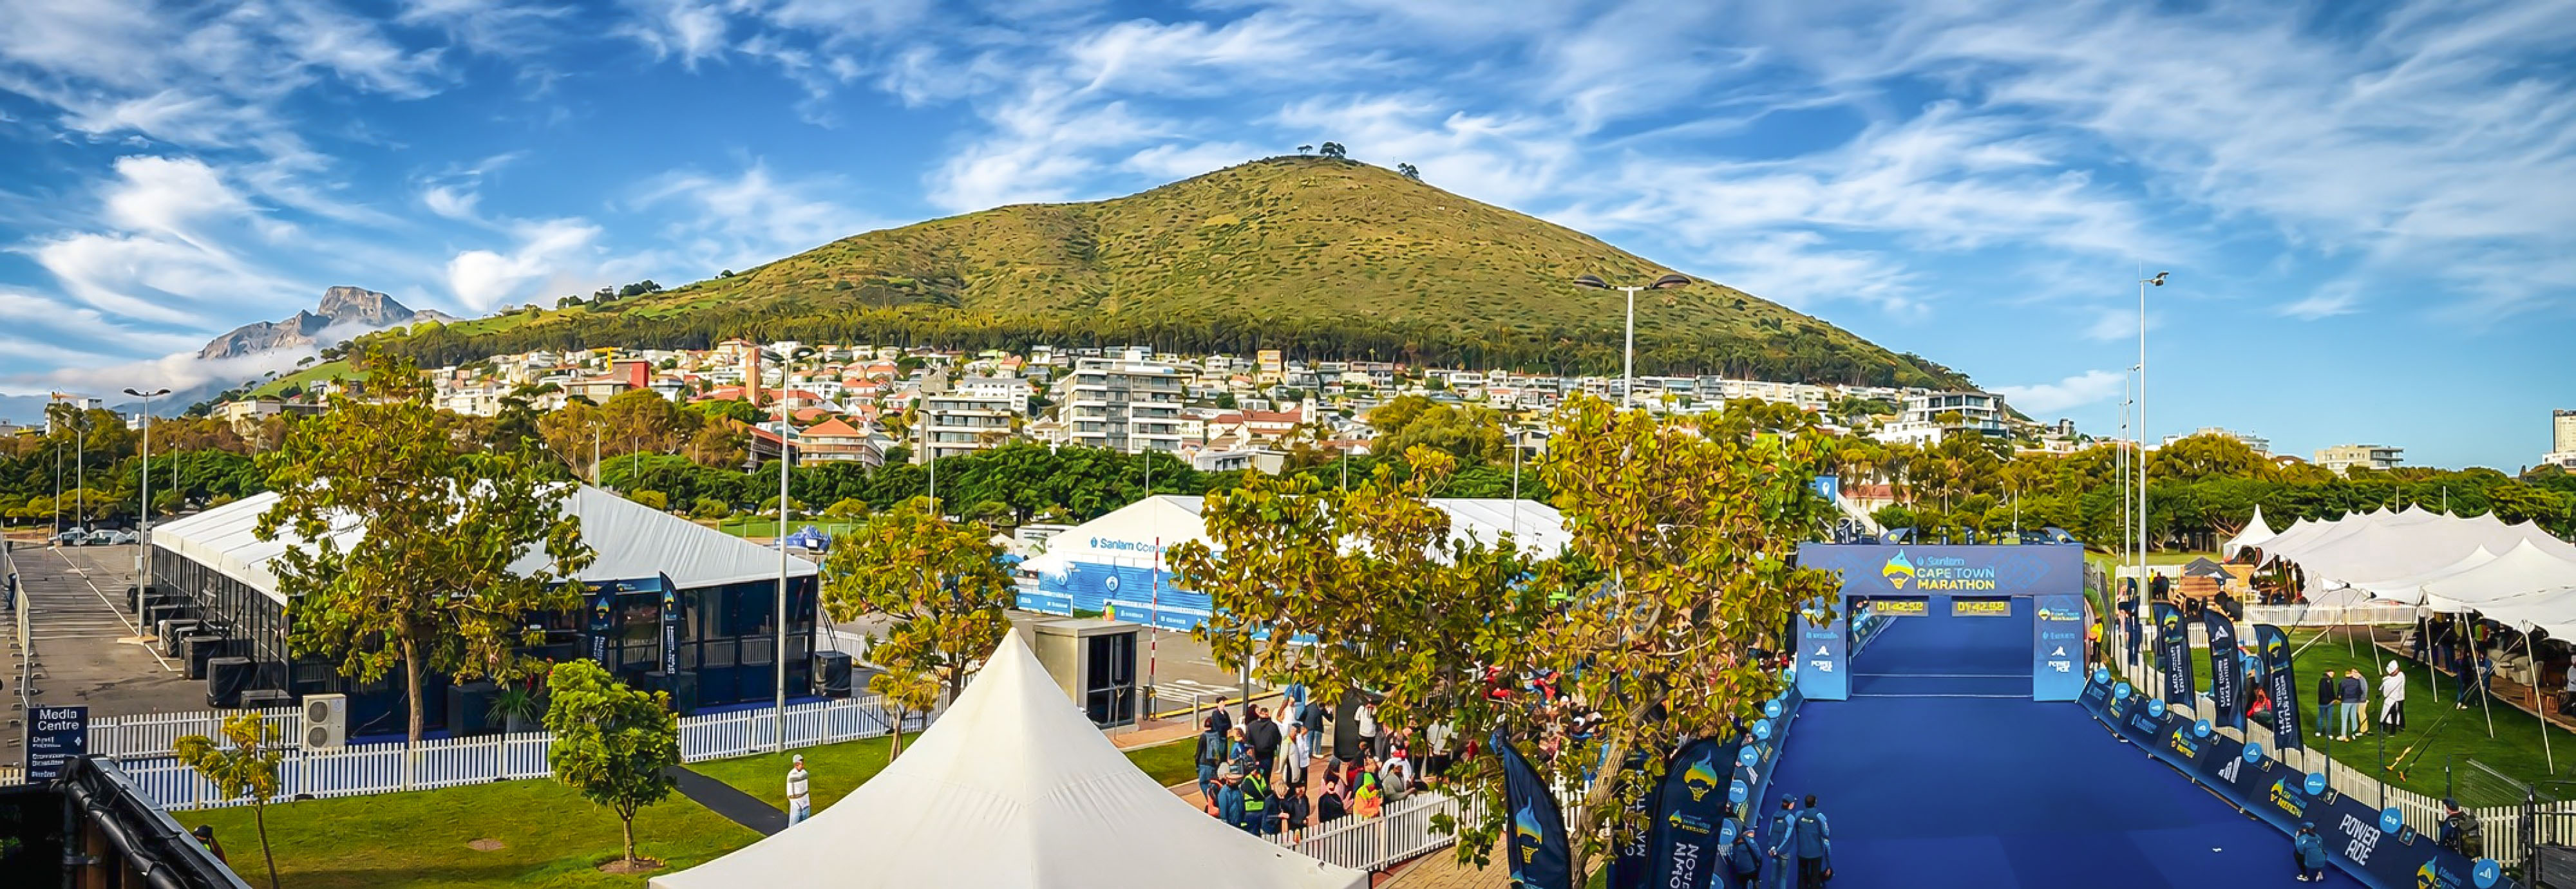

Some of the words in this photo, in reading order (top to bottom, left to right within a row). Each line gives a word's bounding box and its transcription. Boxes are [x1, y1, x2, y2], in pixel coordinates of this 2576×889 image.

[1100, 538, 1134, 550] Sanlam
[1917, 568, 1951, 578] CAPE
[1954, 567, 1995, 578] TOWN
[1917, 579, 1995, 590] MARATHON
[39, 709, 78, 720] Media
[38, 720, 79, 731] Centre
[2339, 813, 2381, 848] POWER
[2345, 839, 2372, 866] ADE
